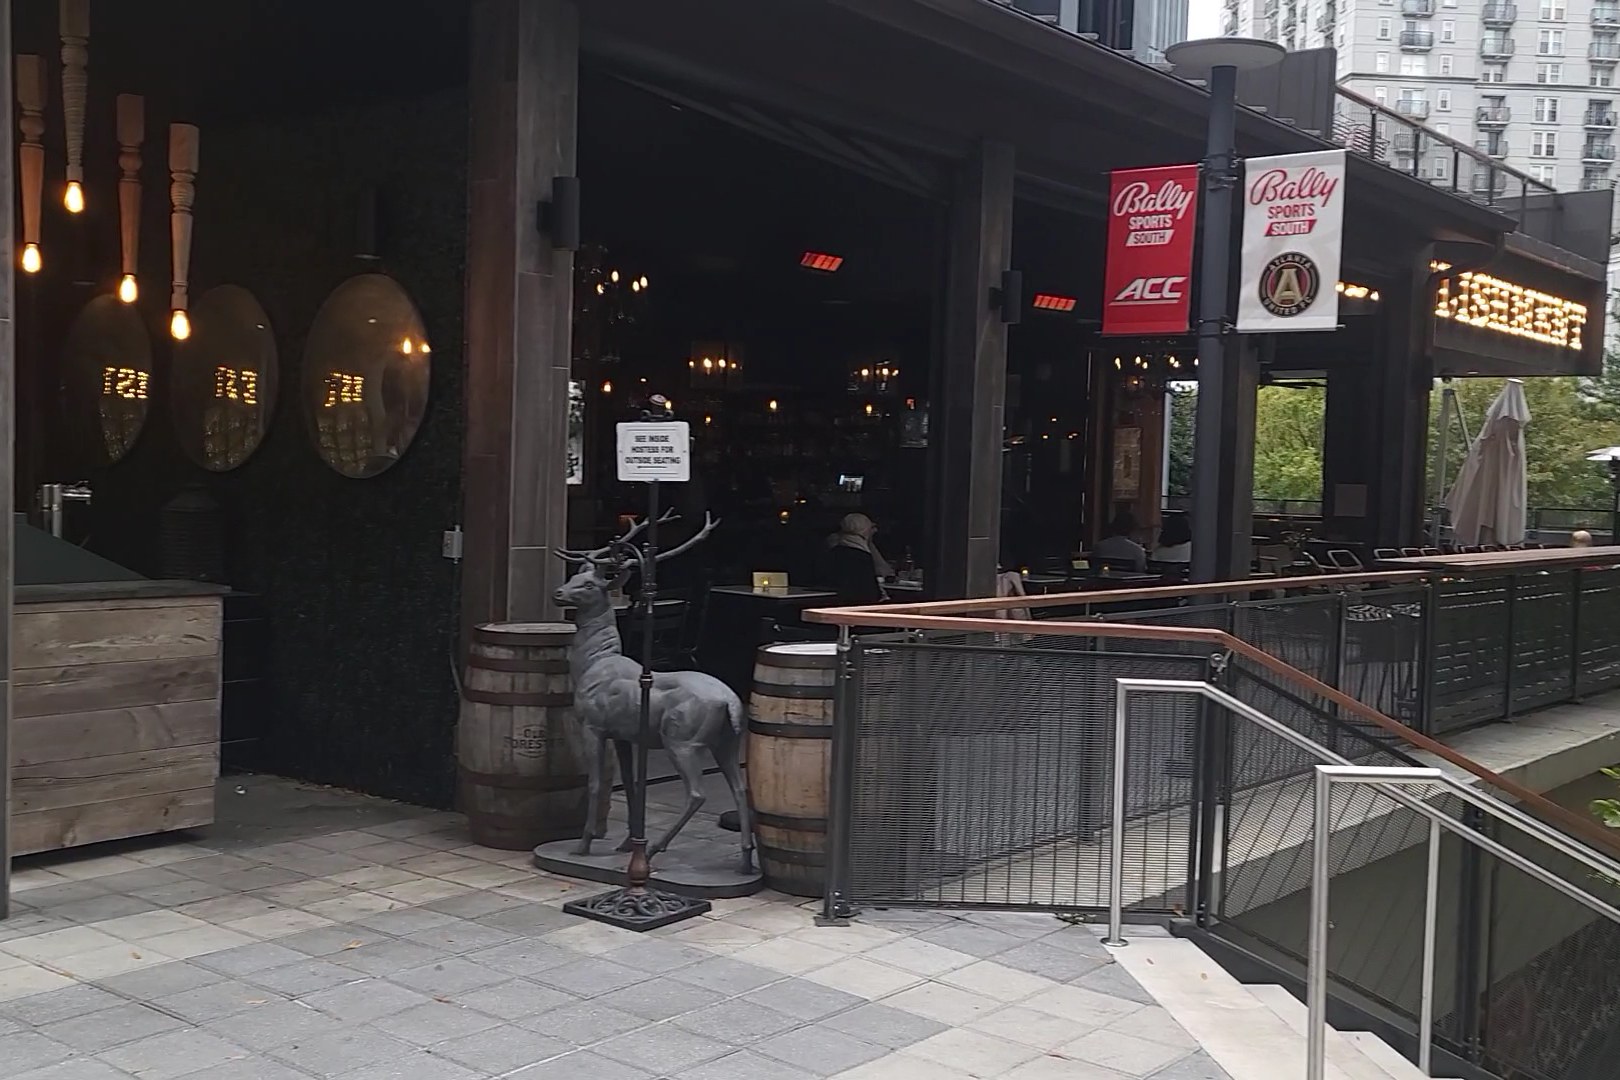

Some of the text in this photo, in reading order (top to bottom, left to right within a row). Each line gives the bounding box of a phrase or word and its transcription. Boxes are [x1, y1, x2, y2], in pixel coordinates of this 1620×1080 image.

[1250, 167, 1339, 207] Bally
[1113, 180, 1194, 219] Bally
[1267, 203, 1315, 220] SPORTS
[1128, 214, 1173, 230] SPORTS
[1271, 221, 1310, 235] SOUTH
[1133, 231, 1167, 244] SOUTH
[1115, 277, 1187, 300] ACC
[634, 435, 670, 443] SEE INSIDE
[625, 456, 681, 464] OUTSIDE SEATING
